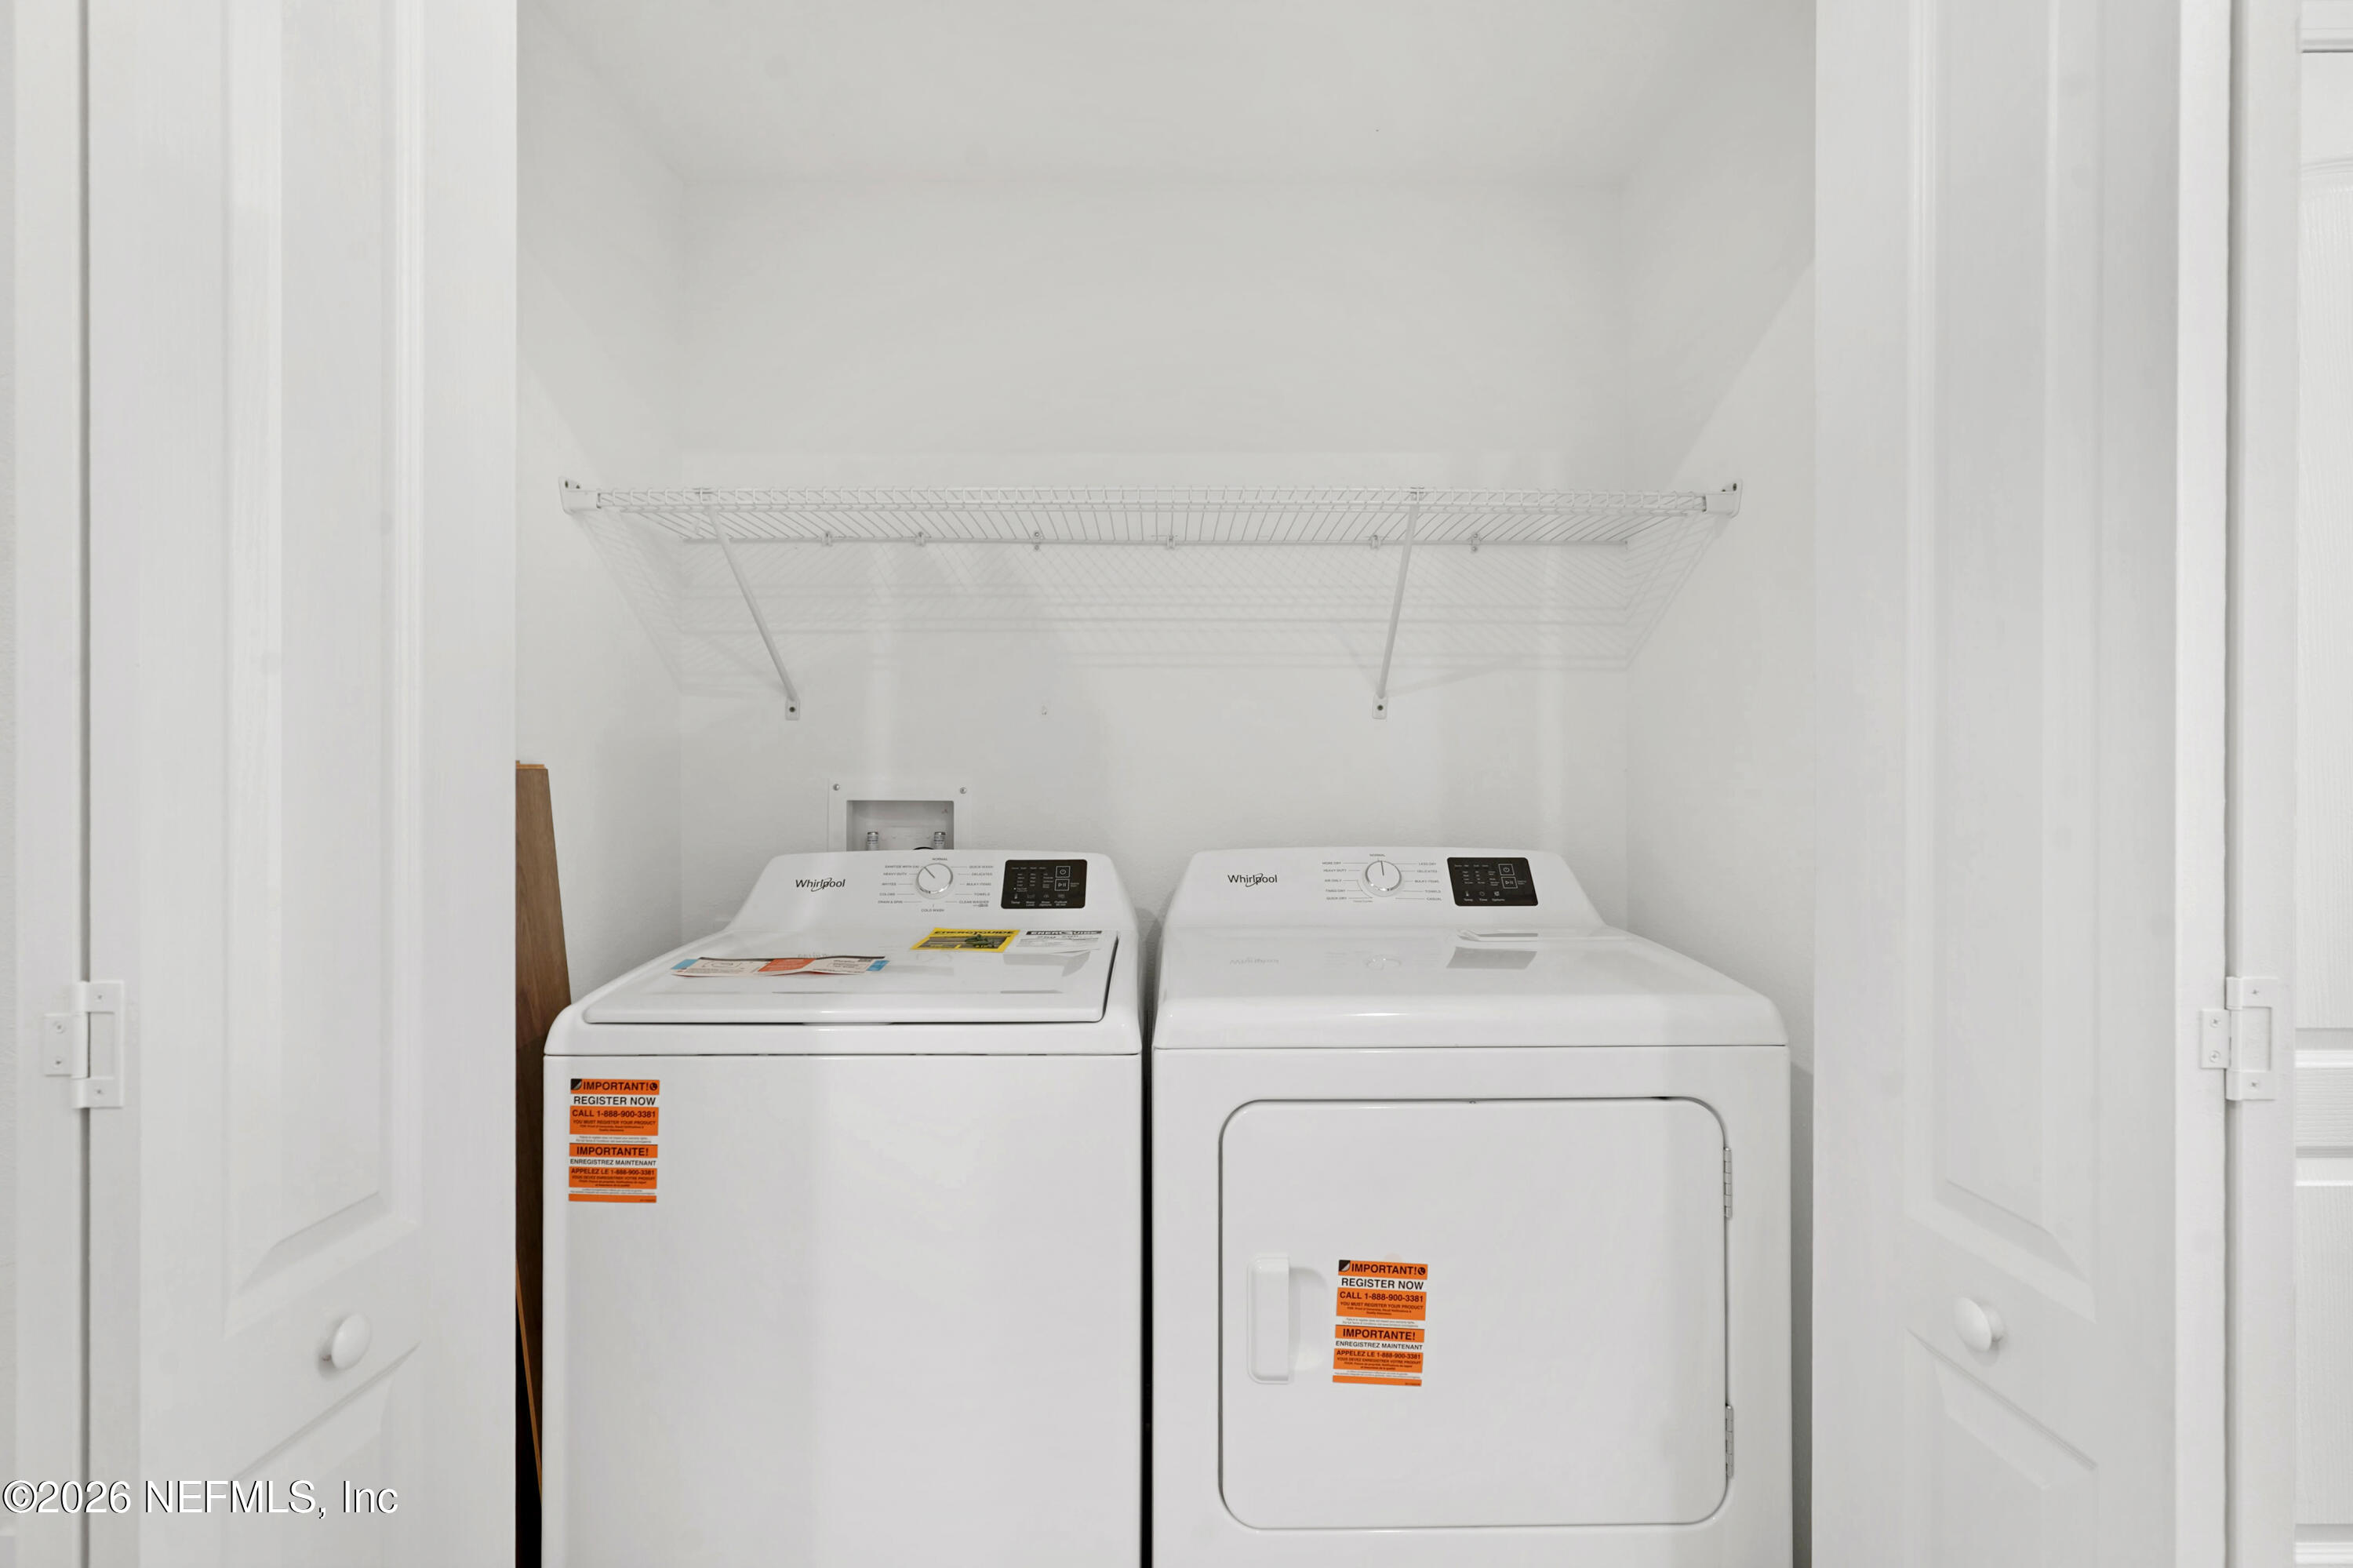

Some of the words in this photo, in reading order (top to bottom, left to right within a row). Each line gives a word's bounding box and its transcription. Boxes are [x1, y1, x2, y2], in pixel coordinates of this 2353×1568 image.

[795, 878, 846, 892] Whirlpool
[1227, 873, 1278, 887] Whirlpool
[583, 1082, 649, 1091] IMPORTANT!
[573, 1096, 627, 1105] REGISTER
[630, 1097, 656, 1105] NOW
[576, 1146, 649, 1156] IMPORTANTE!
[1351, 1263, 1417, 1275] IMPORTANT!
[1341, 1277, 1395, 1289] REGISTER
[1398, 1280, 1424, 1290] NOW
[1364, 1293, 1424, 1302] 1-888-900-3381
[1343, 1328, 1416, 1341] IMPORTANTE!
